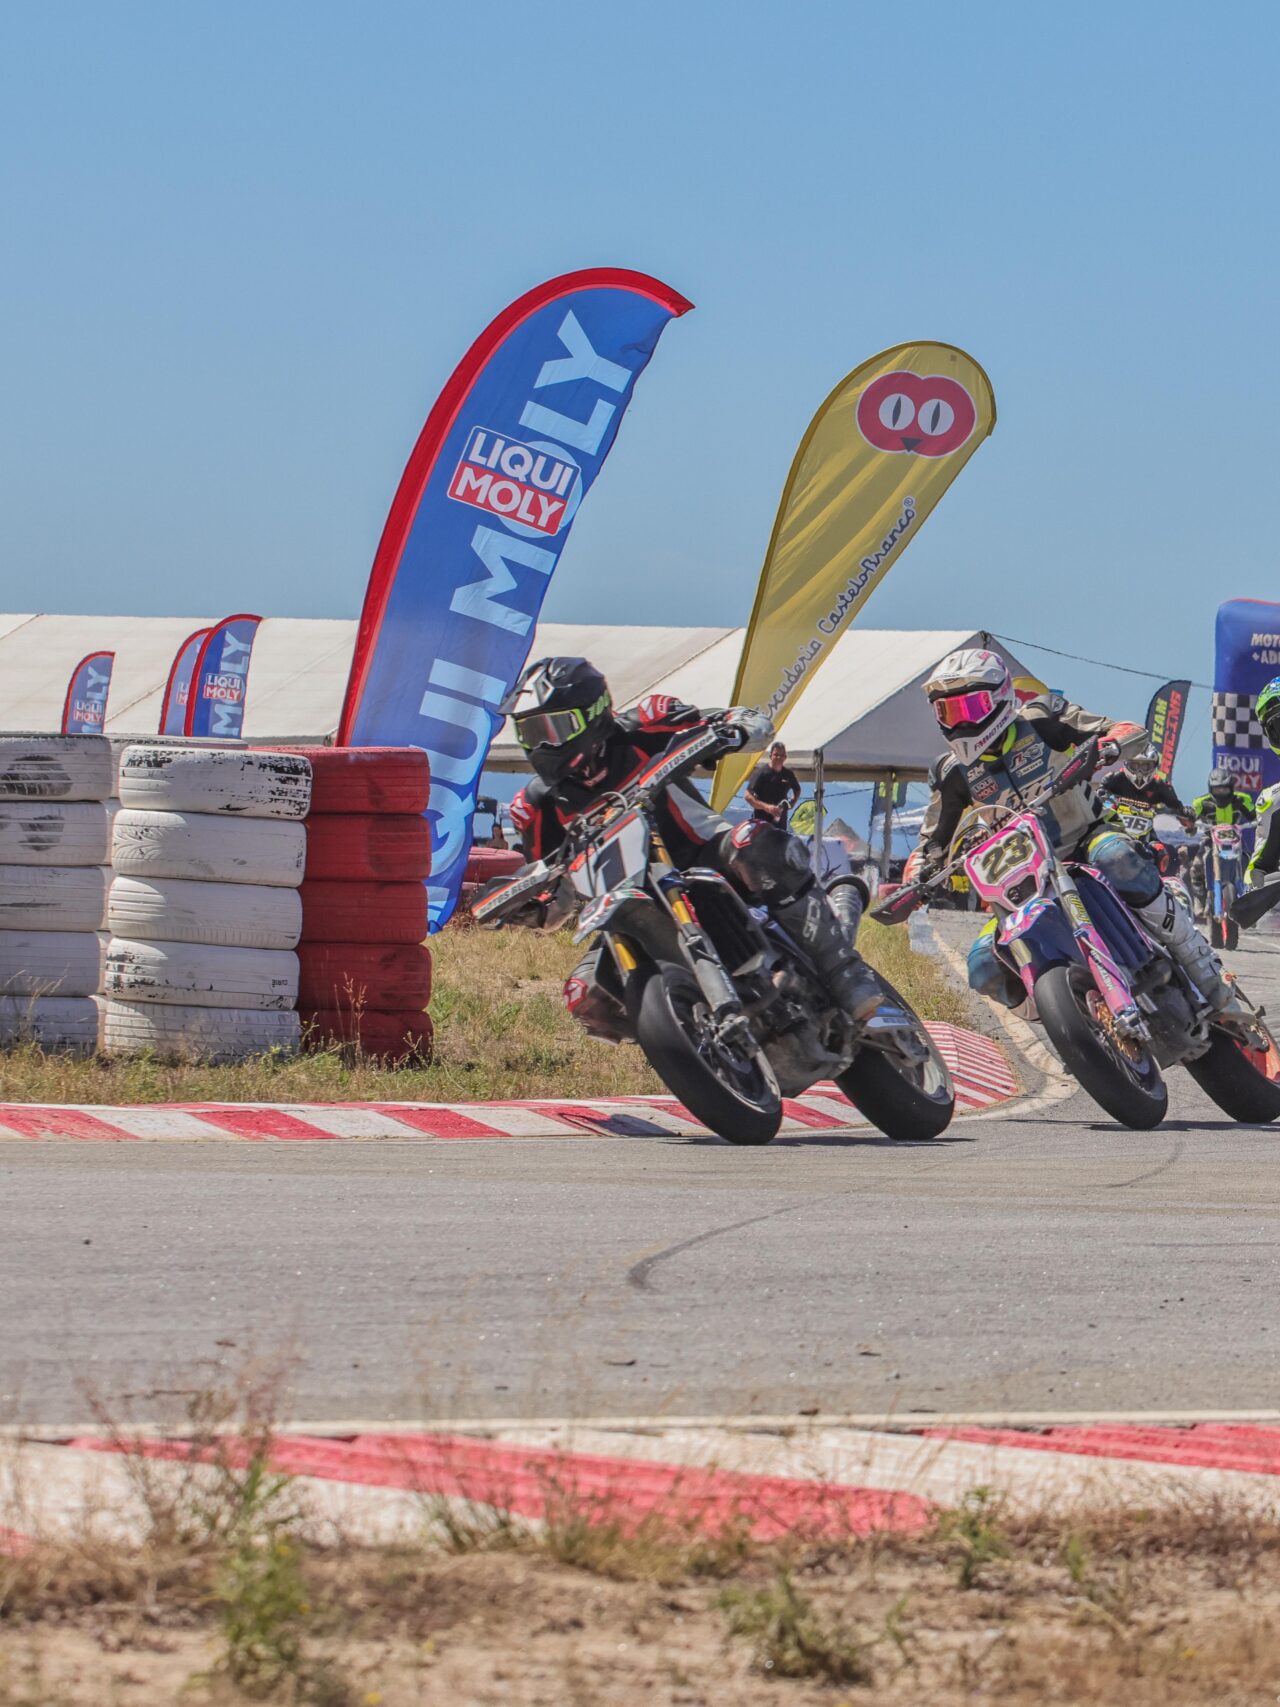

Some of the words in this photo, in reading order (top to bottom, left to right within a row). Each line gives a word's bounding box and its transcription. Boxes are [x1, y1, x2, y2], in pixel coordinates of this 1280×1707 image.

[468, 432, 574, 496] LIQUI
[455, 466, 566, 529] MOLY
[206, 686, 241, 701] MOLY
[207, 675, 242, 690] LIQUI
[757, 638, 823, 720] scuderia
[75, 700, 104, 714] LIQUI
[75, 709, 102, 722] MOLY
[1152, 697, 1168, 744] TEAM
[1160, 690, 1183, 774] RACING
[654, 752, 687, 782] MOTOS
[1233, 774, 1261, 790] OLY
[1123, 816, 1148, 831] 36
[981, 832, 1034, 884] 23
